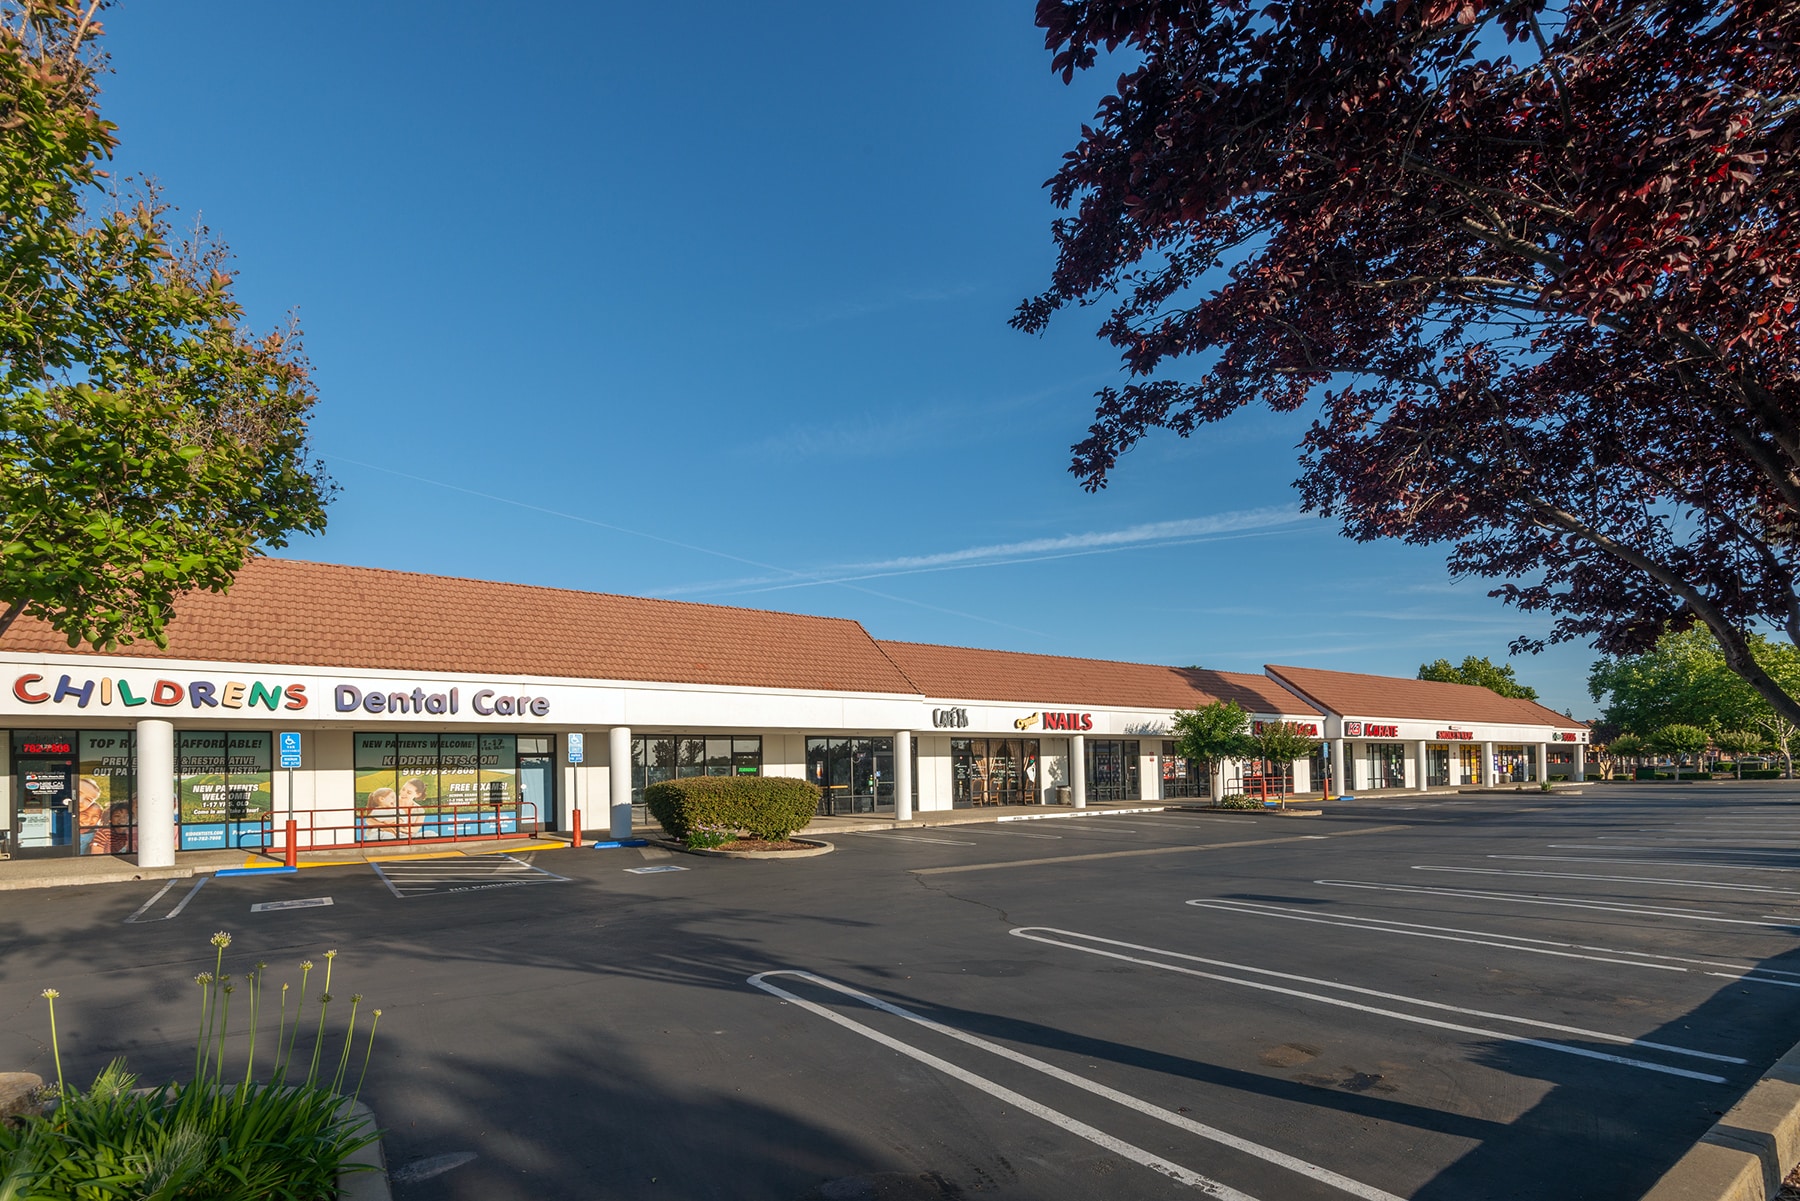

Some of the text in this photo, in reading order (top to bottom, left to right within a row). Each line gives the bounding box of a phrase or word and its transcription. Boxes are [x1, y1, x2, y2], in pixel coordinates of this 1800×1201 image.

[13, 673, 550, 716] CHILDRENS Dental Care
[1042, 712, 1093, 731] NAILS
[1364, 723, 1398, 737] KARATE
[89, 739, 115, 748] TOP
[181, 739, 262, 749] AFFORDABLE!
[362, 740, 475, 748] NEW PATIENTS WELCOME!
[190, 757, 255, 765] RESTORATIVE
[382, 755, 499, 766] KIDDENTISTS.COM
[93, 767, 112, 777] OUT
[402, 768, 475, 776] 916-782-7808
[192, 784, 259, 793] NEW PATIENTS
[450, 782, 508, 792] FREE EXAMS!
[202, 792, 251, 801] WELCOME!
[472, 881, 526, 890] PARKING
